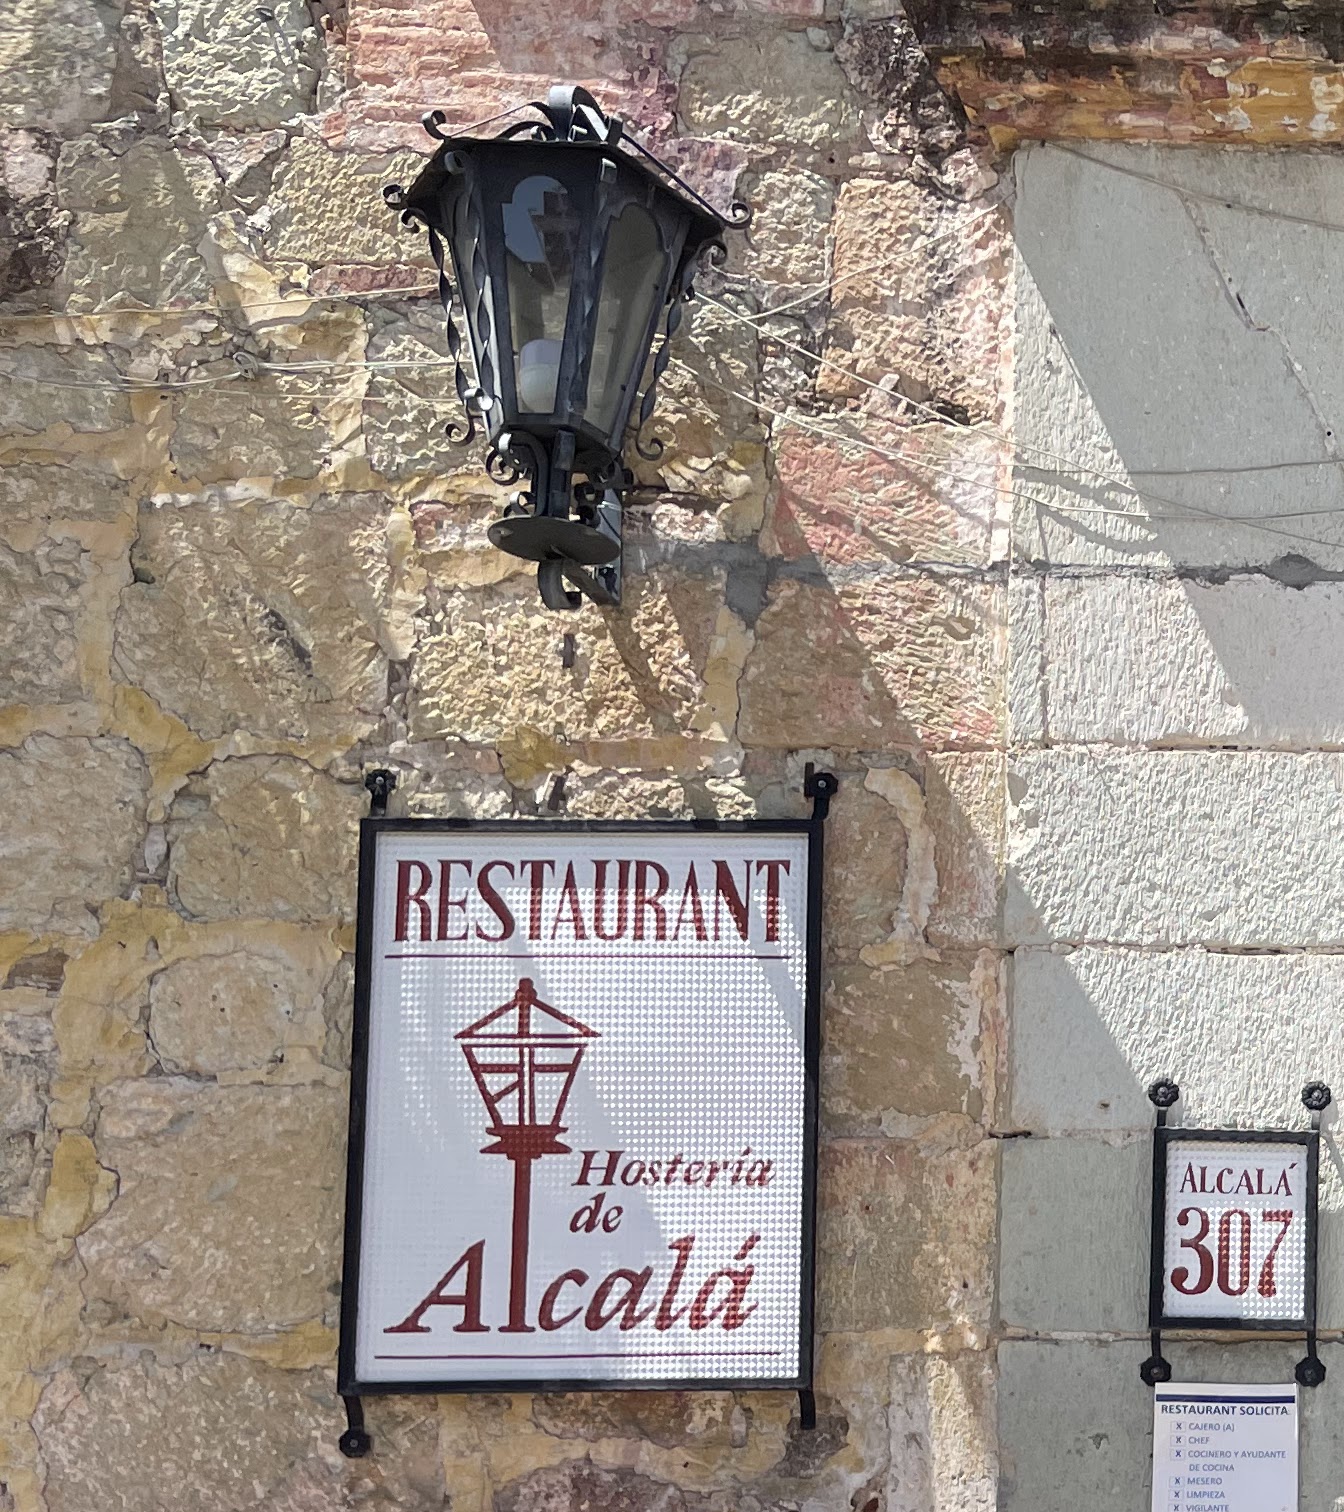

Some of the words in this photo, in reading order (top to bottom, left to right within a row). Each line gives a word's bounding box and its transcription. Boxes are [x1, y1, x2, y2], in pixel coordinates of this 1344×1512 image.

[394, 858, 790, 943] RESTAURANT
[572, 1148, 773, 1187] Hostería
[1180, 1161, 1298, 1197] ALCALÁ
[570, 1193, 624, 1234] de
[1170, 1207, 1293, 1297] 307
[383, 1234, 759, 1334] Alcalá
[1161, 1404, 1237, 1415] RESTAURANT
[1176, 1422, 1182, 1430] X
[1188, 1423, 1220, 1431] CAJERO
[1223, 1423, 1235, 1432] (A)
[1176, 1436, 1182, 1444] X
[1175, 1450, 1181, 1458] X
[1189, 1464, 1200, 1472] DE
[1202, 1464, 1235, 1472] COCINA
[1174, 1477, 1181, 1485] X
[1174, 1491, 1180, 1499] X
[1186, 1491, 1225, 1499] LIMPIEZA
[1173, 1504, 1180, 1512] X
[1186, 1504, 1229, 1512] VIGILANTE
